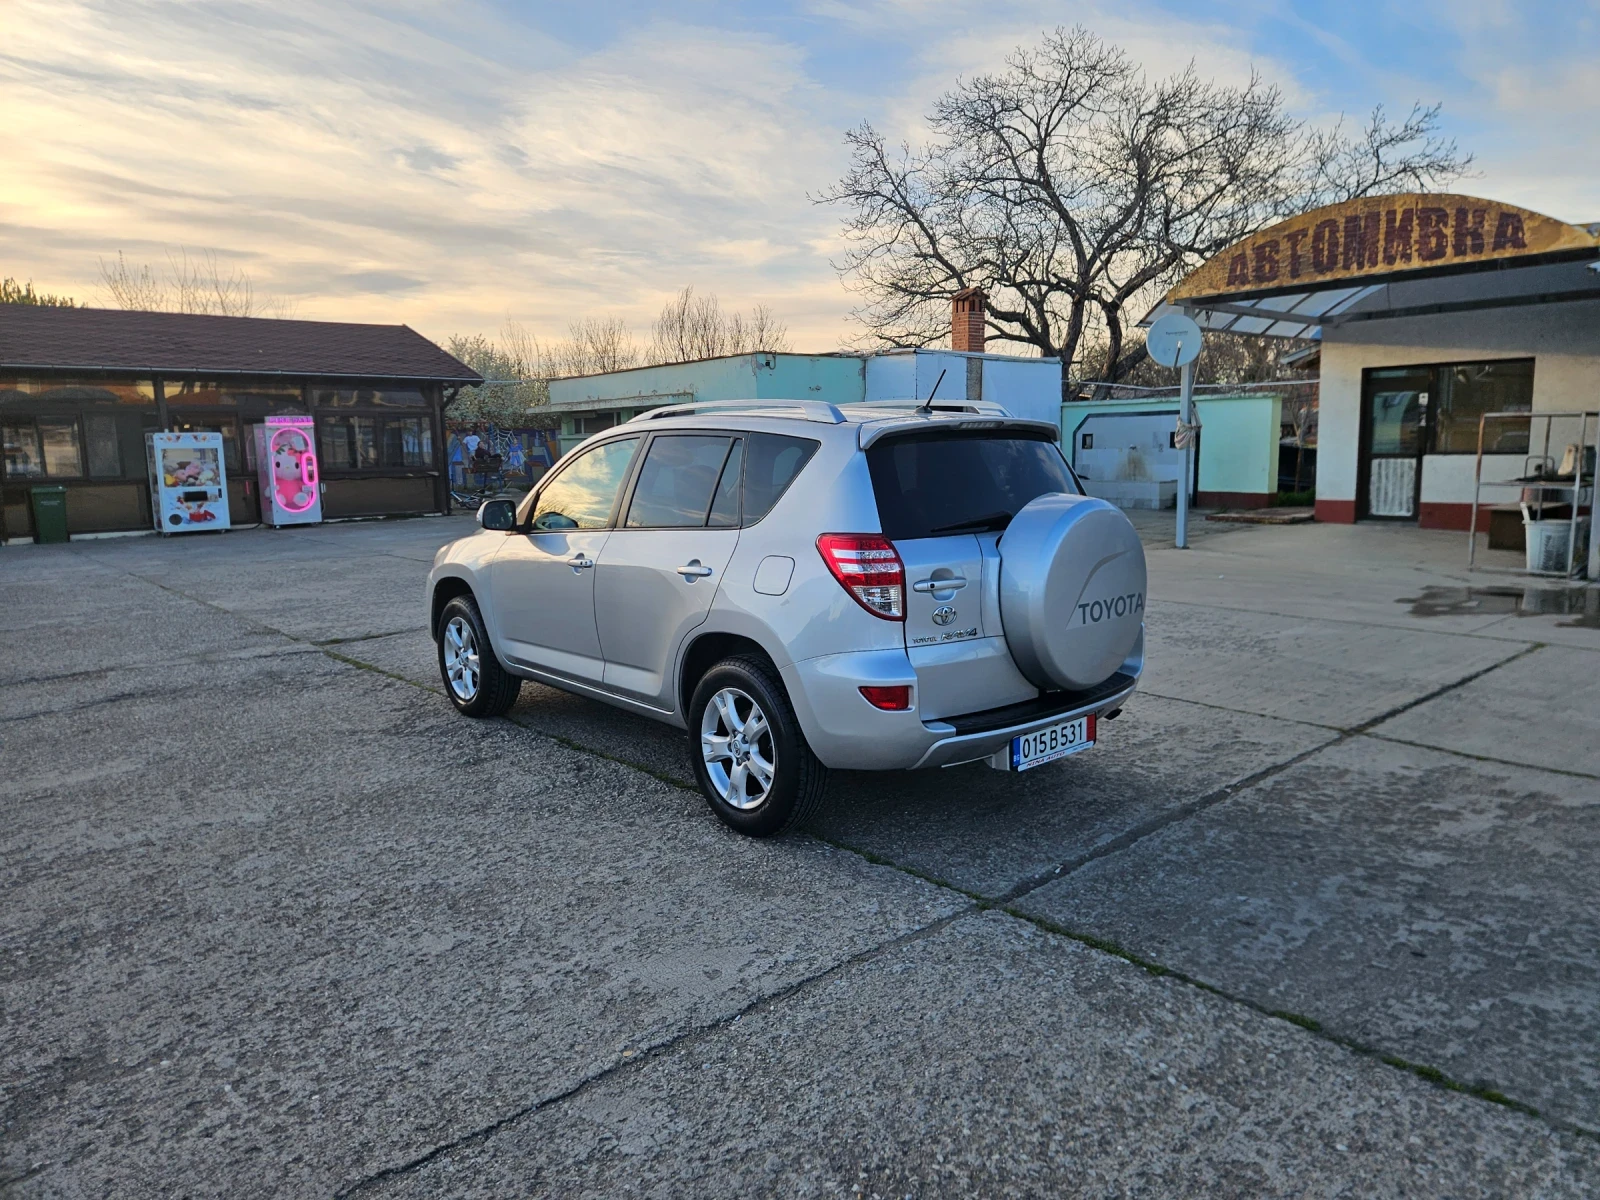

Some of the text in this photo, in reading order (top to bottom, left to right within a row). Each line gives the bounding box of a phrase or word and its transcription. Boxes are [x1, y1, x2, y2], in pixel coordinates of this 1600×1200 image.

[1226, 207, 1527, 287] АВТОМИВКА
[1078, 592, 1144, 625] TOYOTA
[1026, 751, 1066, 767] NINA AUTO
